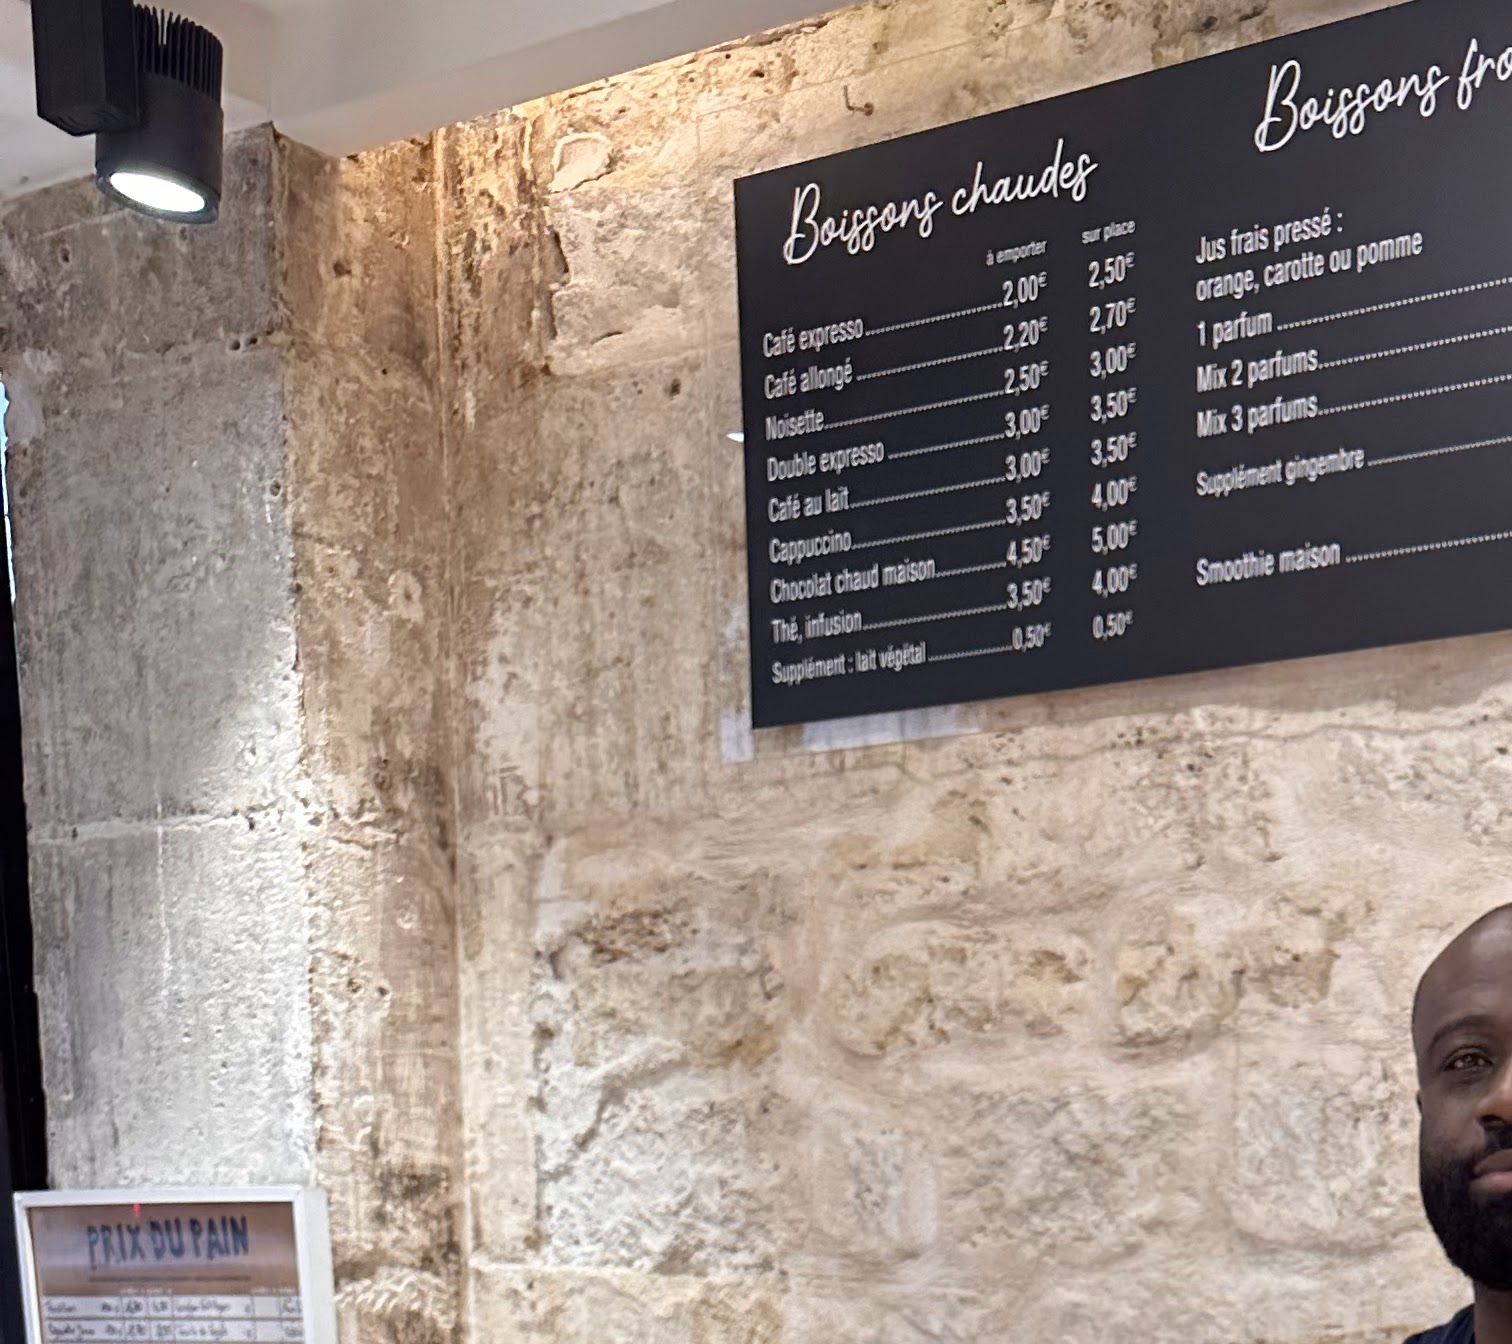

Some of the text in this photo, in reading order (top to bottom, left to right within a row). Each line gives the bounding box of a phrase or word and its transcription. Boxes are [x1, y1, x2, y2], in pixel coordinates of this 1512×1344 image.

[1255, 60, 1450, 152] Boissons
[783, 138, 1098, 265] Boissons chaudes
[1196, 207, 1332, 264] Jus frais pressé
[1196, 231, 1423, 302] orange, carotte ou pomme
[763, 252, 1135, 358] Café expresso 2,00€ 2,50€
[1198, 322, 1207, 346] 1
[1212, 310, 1272, 349] parfum
[764, 298, 1136, 400] Café allongé 2,20€ 2,70€
[1197, 366, 1226, 392] Mix
[1231, 360, 1243, 387] 2
[1248, 348, 1318, 388] parfums
[766, 342, 1137, 440] Noisette 2,50€ 3,00€
[1197, 463, 1282, 497] Supplément
[1285, 448, 1364, 487] gingembre
[1196, 549, 1274, 586] Smoothie
[1279, 542, 1340, 573] maison
